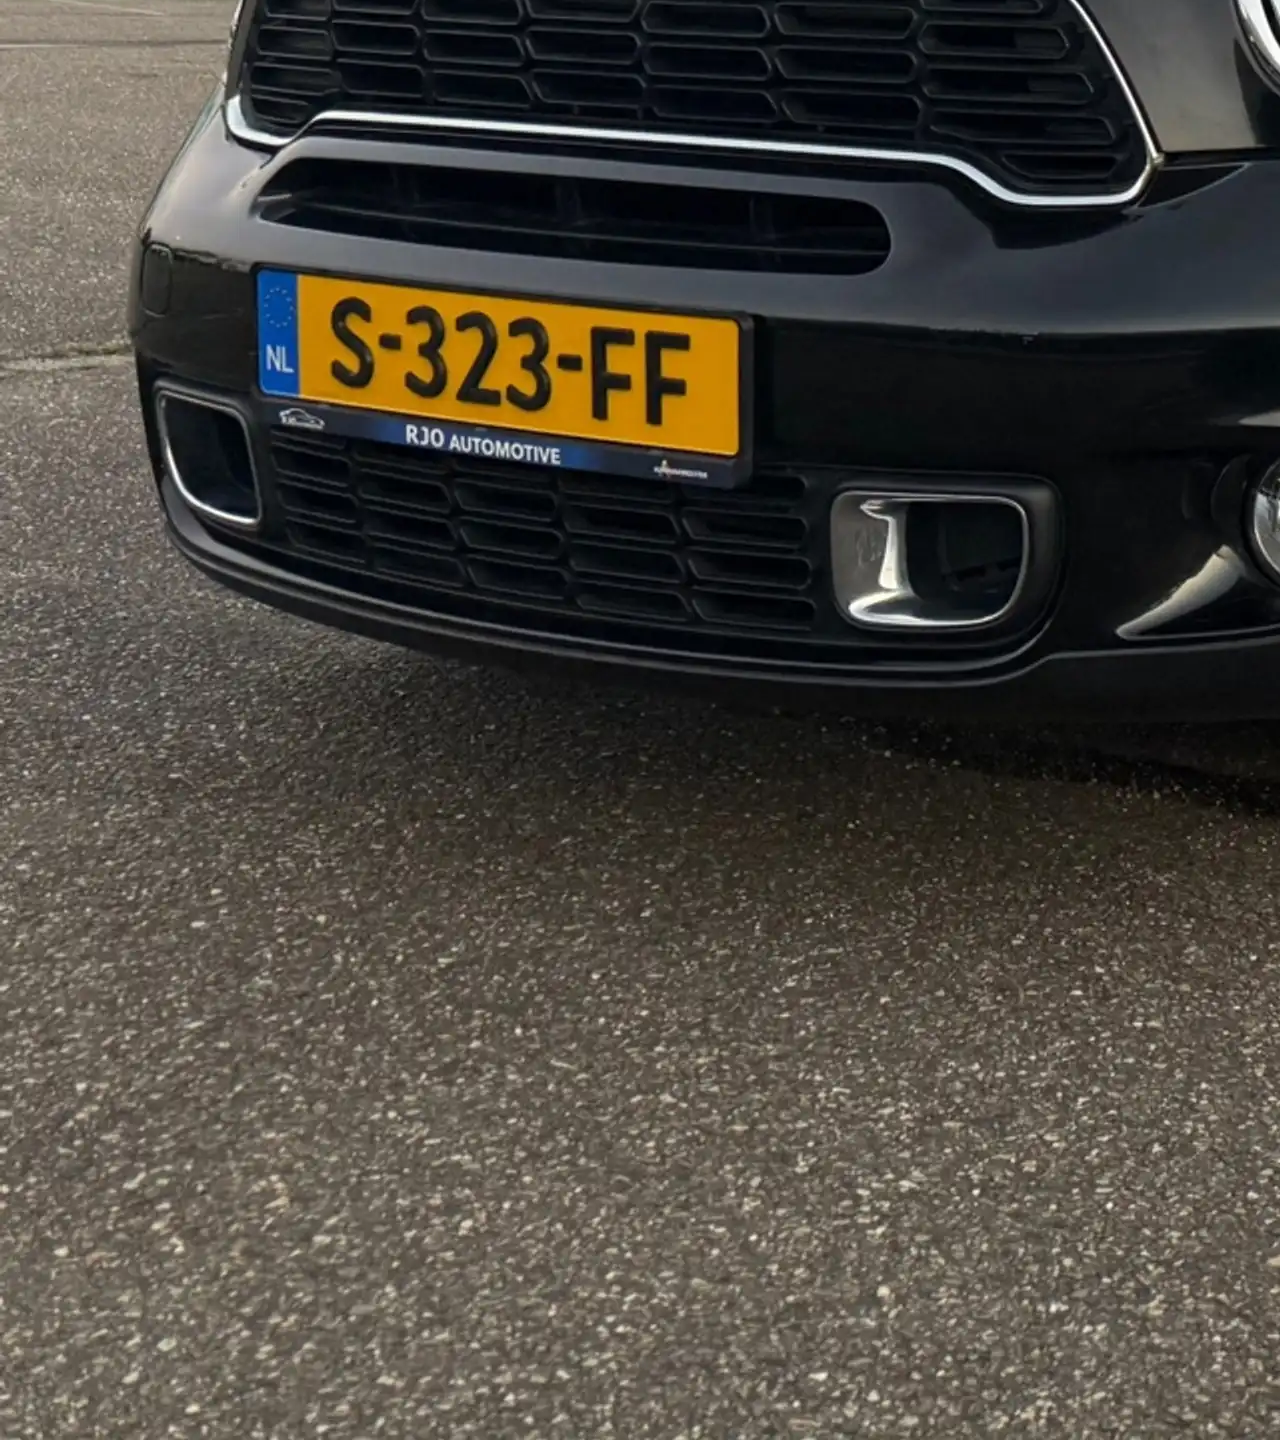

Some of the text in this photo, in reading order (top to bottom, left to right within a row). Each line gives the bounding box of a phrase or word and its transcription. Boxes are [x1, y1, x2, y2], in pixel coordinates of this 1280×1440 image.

[265, 344, 294, 374] NL
[331, 297, 691, 426] S-323-FF
[405, 424, 561, 465] RJO AUTOMOTIVE
